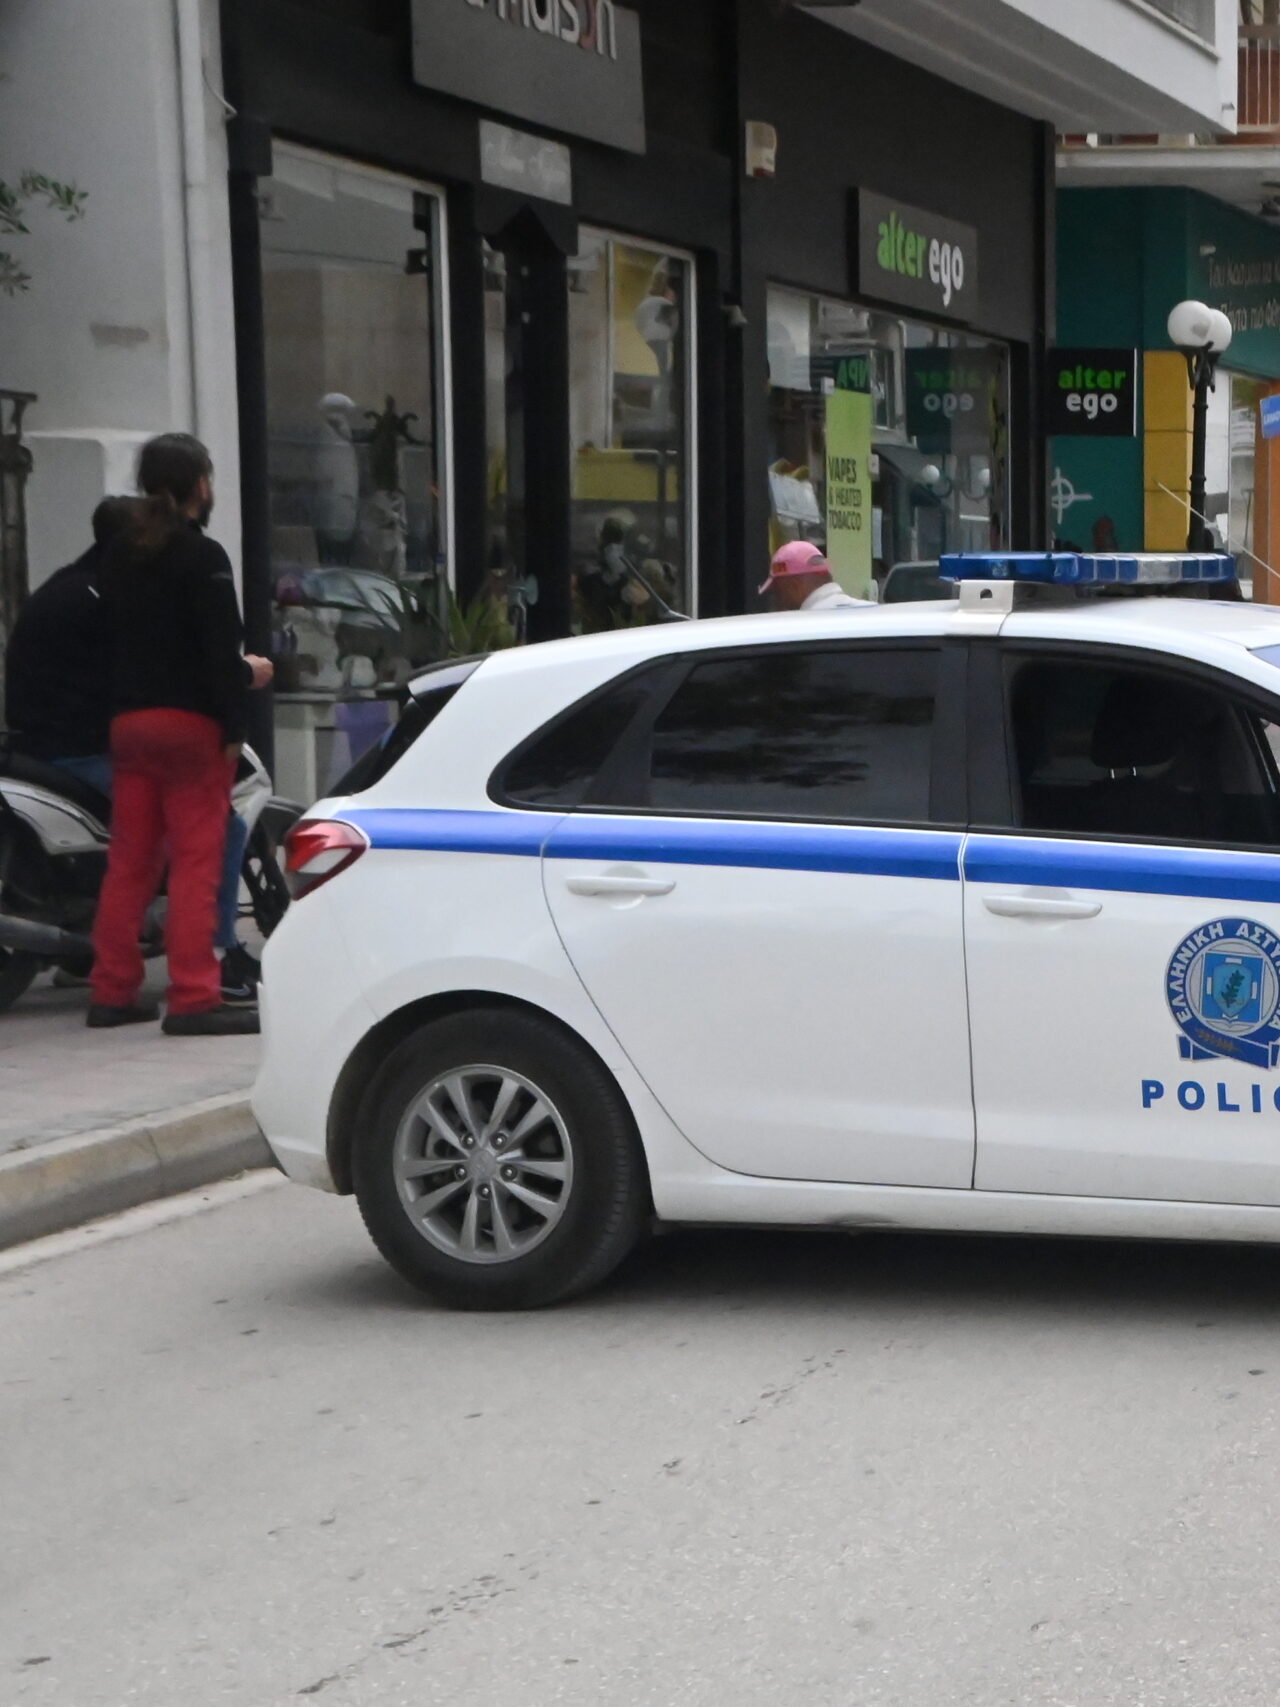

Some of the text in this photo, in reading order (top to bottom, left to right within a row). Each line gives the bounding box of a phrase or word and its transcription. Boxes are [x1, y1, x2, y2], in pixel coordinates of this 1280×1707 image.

[877, 211, 964, 306] alter ego
[1058, 360, 1126, 390] alter
[1066, 392, 1118, 419] ego
[828, 456, 857, 483] VAPES
[836, 488, 862, 507] HEATED
[828, 510, 862, 531] TOBACCO
[1169, 922, 1224, 1024] ΕΛΛΗΝΙΚΗ
